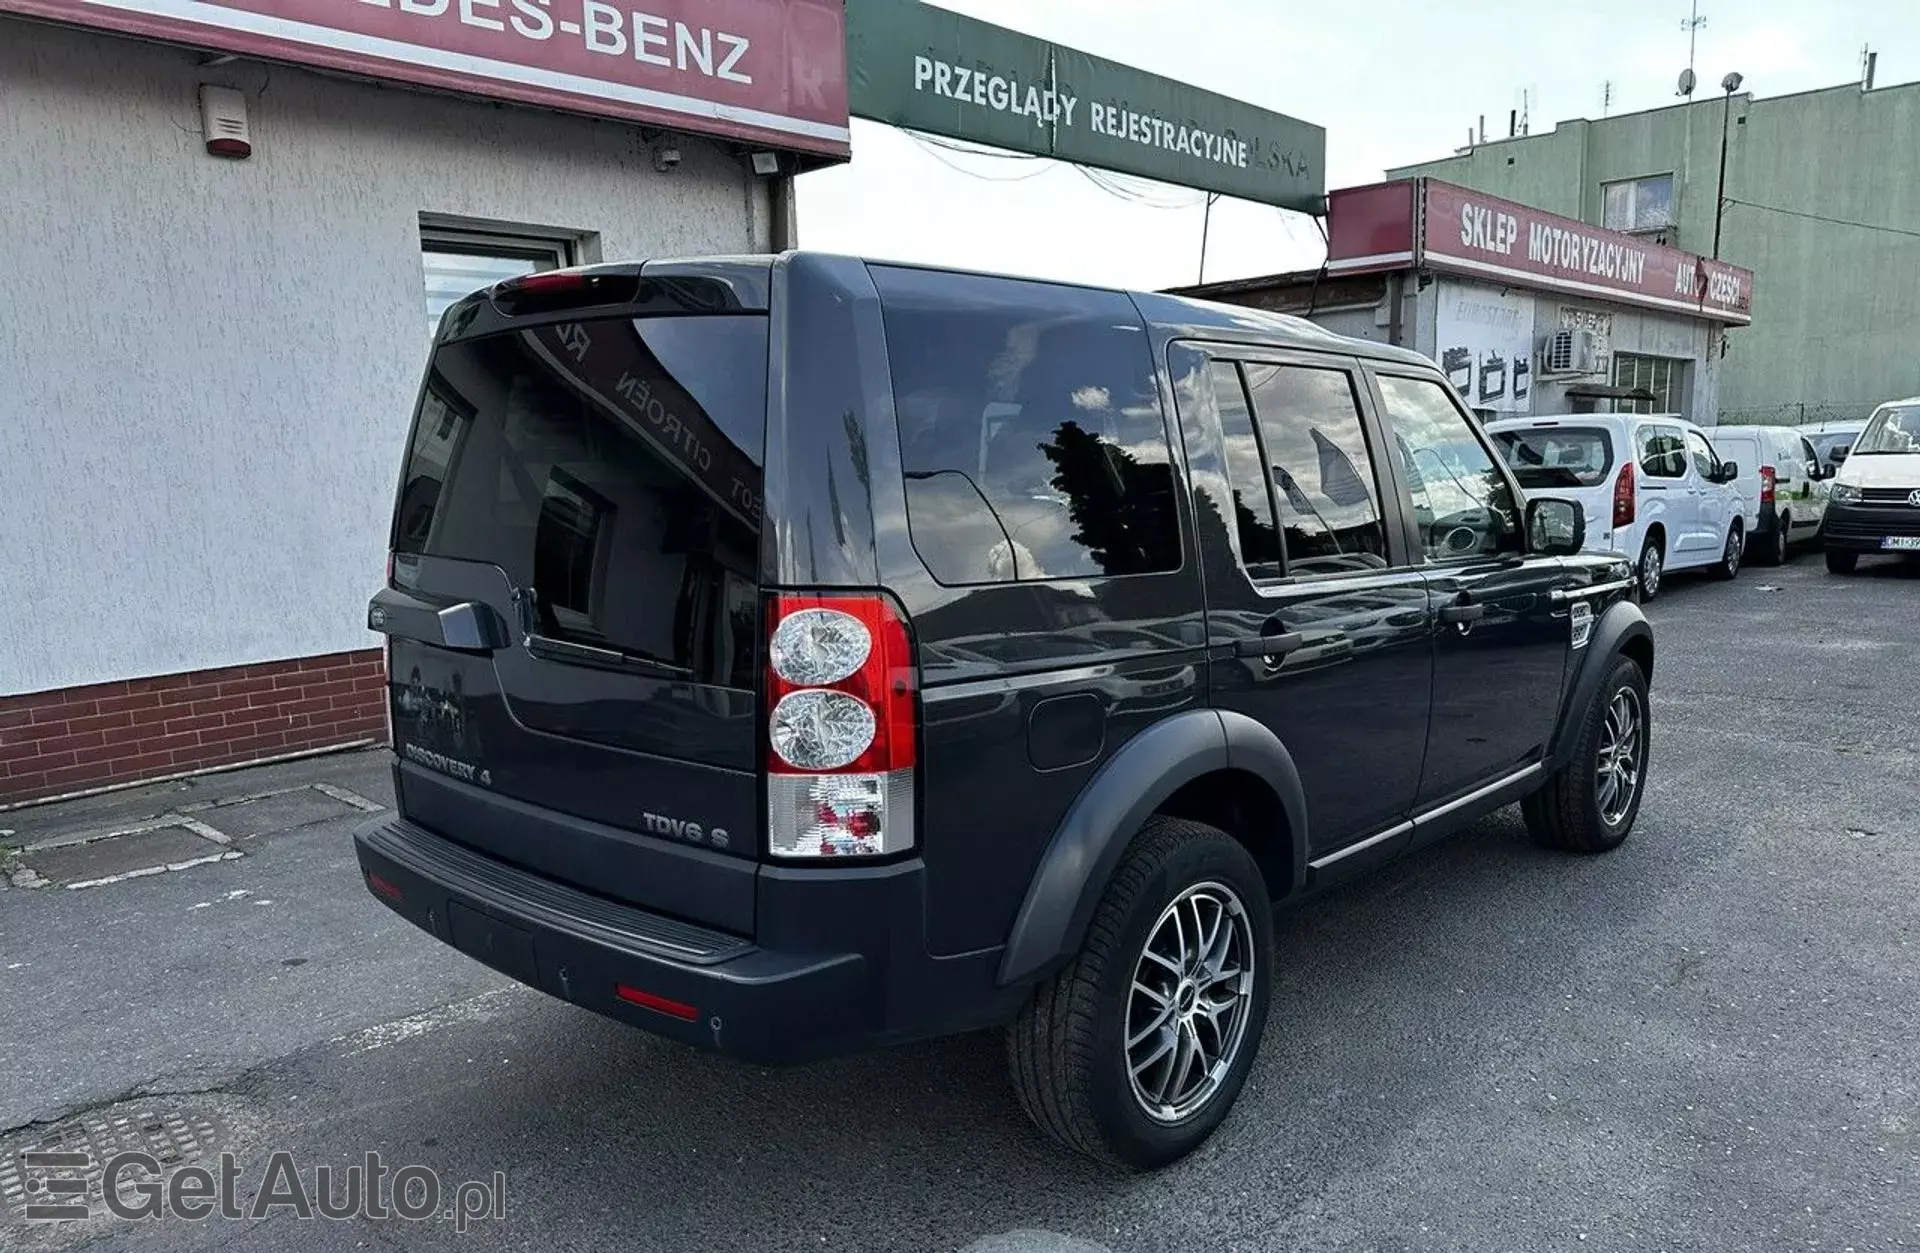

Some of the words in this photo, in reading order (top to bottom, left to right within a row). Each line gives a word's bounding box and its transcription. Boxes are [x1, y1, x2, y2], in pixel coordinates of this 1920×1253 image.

[1090, 101, 1248, 168] REJESTRACYJNE
[1461, 203, 1517, 255] SKLEP
[1528, 222, 1646, 285] MOTORYZACYJNY
[406, 742, 475, 781] DISCOVERY
[480, 769, 491, 785] 4
[643, 812, 703, 842] TDV6
[711, 828, 729, 848] S
